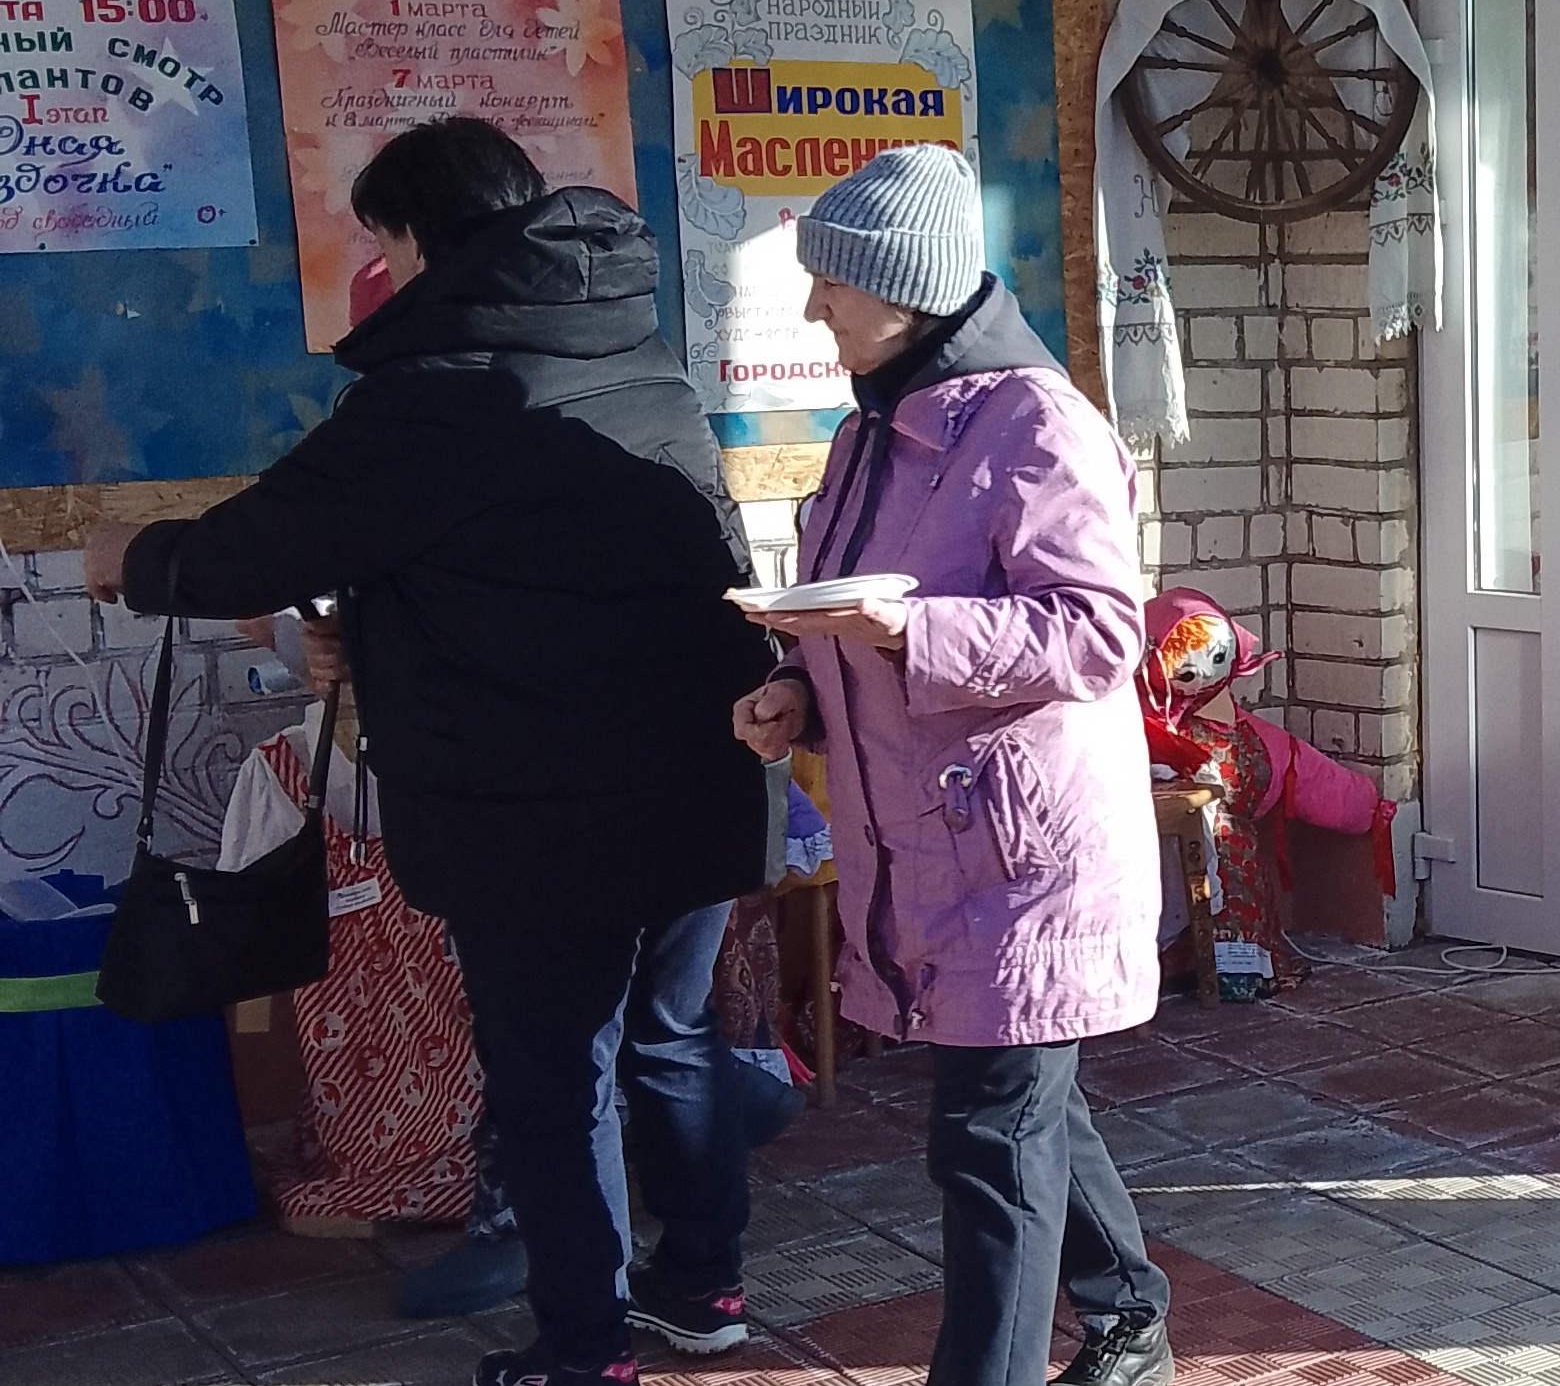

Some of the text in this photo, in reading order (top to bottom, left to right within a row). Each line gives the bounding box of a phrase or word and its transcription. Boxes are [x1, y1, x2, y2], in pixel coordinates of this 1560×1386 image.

[407, 1, 489, 19] марта
[767, 21, 882, 46] праздник
[107, 37, 224, 106] смотр
[392, 68, 496, 90] 7 марта
[711, 67, 946, 117] Широкая
[46, 106, 110, 124] этап
[699, 119, 962, 178] Маслен
